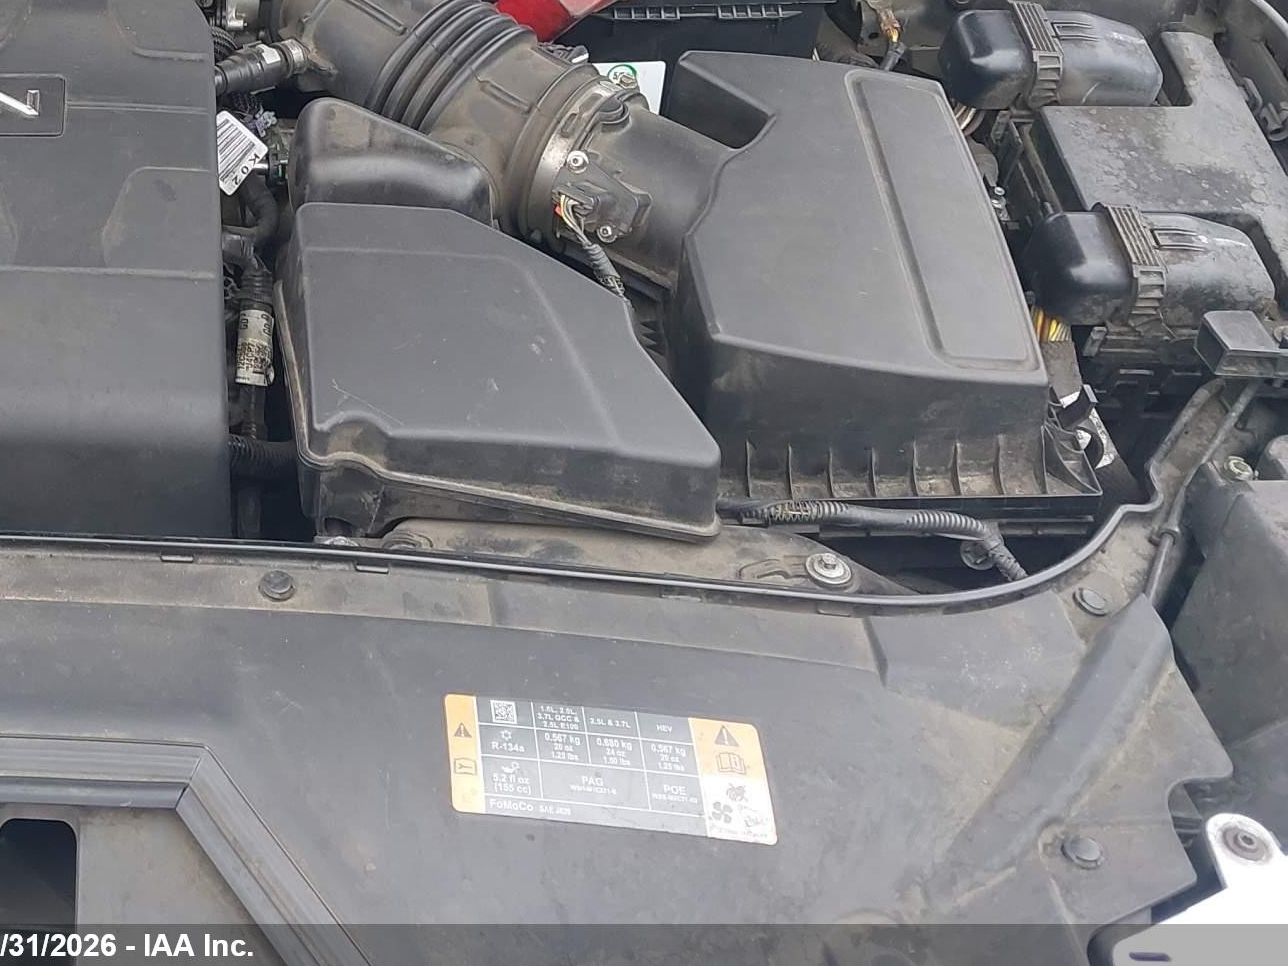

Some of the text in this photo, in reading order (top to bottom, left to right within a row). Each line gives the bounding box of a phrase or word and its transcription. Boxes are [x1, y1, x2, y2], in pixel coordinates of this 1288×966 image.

[569, 733, 581, 746] kg
[620, 738, 633, 752] kg
[491, 740, 525, 753] R-134a
[492, 772, 507, 783] 5.2
[663, 783, 687, 796] POE
[489, 798, 535, 812] FoMoCo
